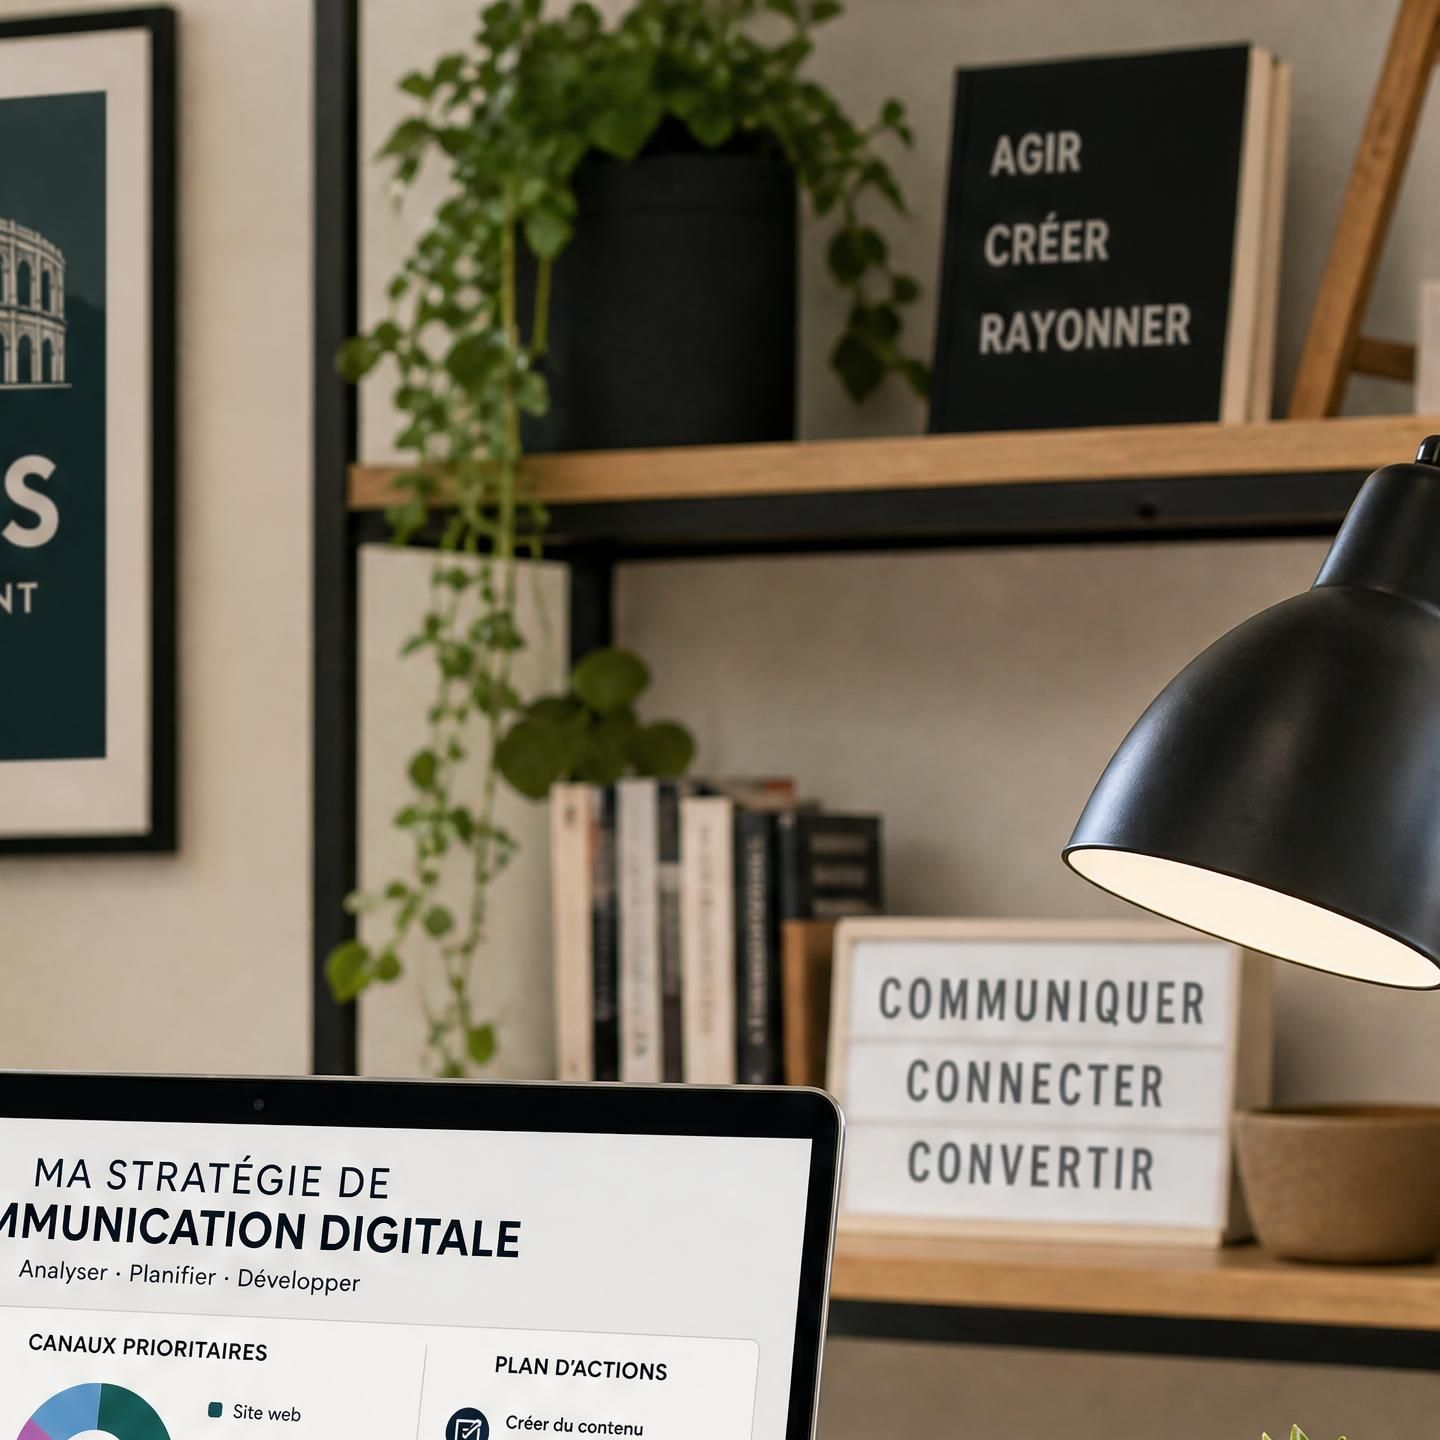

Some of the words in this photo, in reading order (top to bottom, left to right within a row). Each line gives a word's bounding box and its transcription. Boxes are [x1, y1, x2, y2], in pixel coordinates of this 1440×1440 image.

[990, 130, 1082, 176] AGIR
[984, 211, 1109, 267] CRÉER
[979, 303, 1191, 354] RAYONNER
[879, 976, 1204, 1027] COMMUNIQUER
[906, 1059, 1163, 1108] CONNECTER
[34, 1157, 92, 1189] MA
[106, 1154, 322, 1197] STRATÉGIE
[338, 1166, 390, 1200] DE
[908, 1140, 1154, 1191] CONVERTIR
[319, 1214, 522, 1258] DIGITALE
[18, 1259, 109, 1285] Analyser
[129, 1263, 217, 1286] Planifier
[237, 1268, 361, 1297] Développer
[28, 1333, 117, 1355] CANAUX
[123, 1337, 268, 1362] PRIORITAIRES
[495, 1355, 549, 1375] PLAN
[233, 1403, 264, 1421] Site
[267, 1406, 301, 1422] web
[505, 1414, 550, 1431] Créer
[553, 1417, 574, 1433] du
[578, 1421, 644, 1437] contenu
